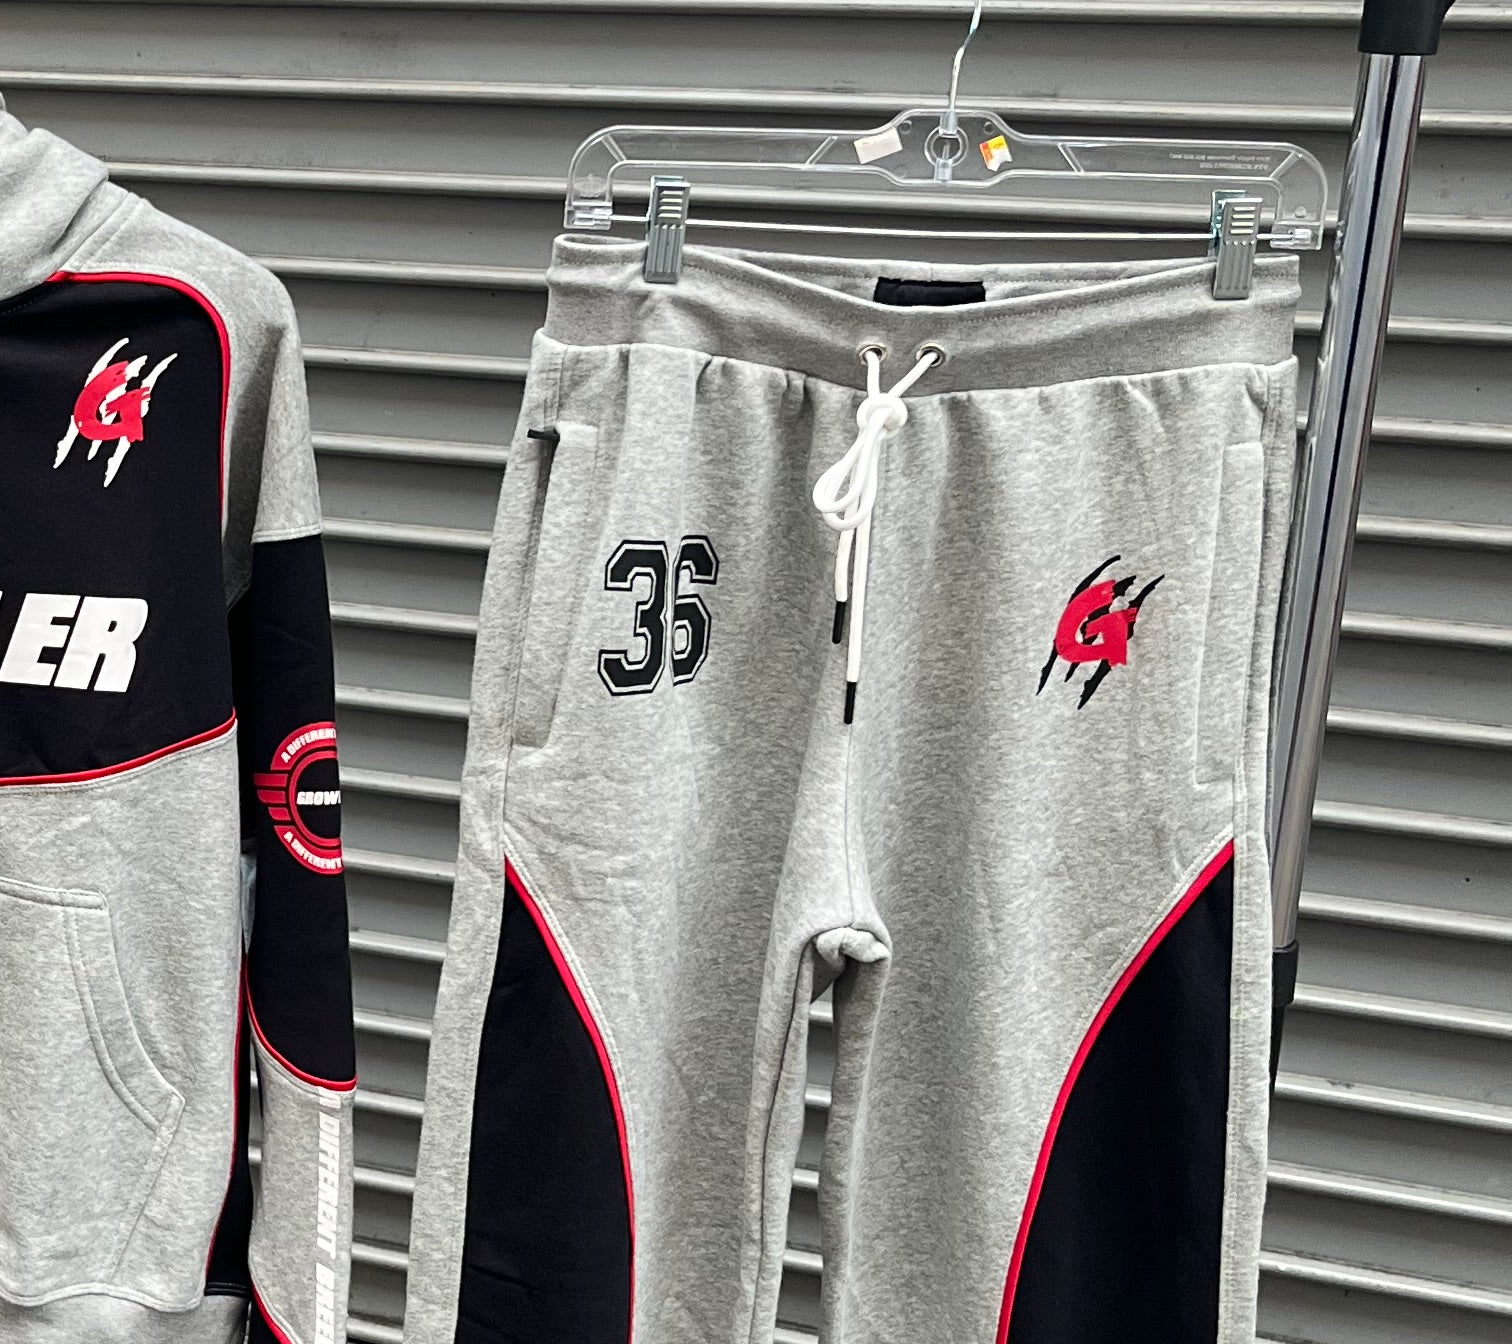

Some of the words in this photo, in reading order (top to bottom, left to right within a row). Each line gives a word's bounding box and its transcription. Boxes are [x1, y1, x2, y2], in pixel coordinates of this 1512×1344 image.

[597, 534, 720, 697] 36
[281, 752, 292, 764] A
[317, 1111, 340, 1260] DIFFERENT
